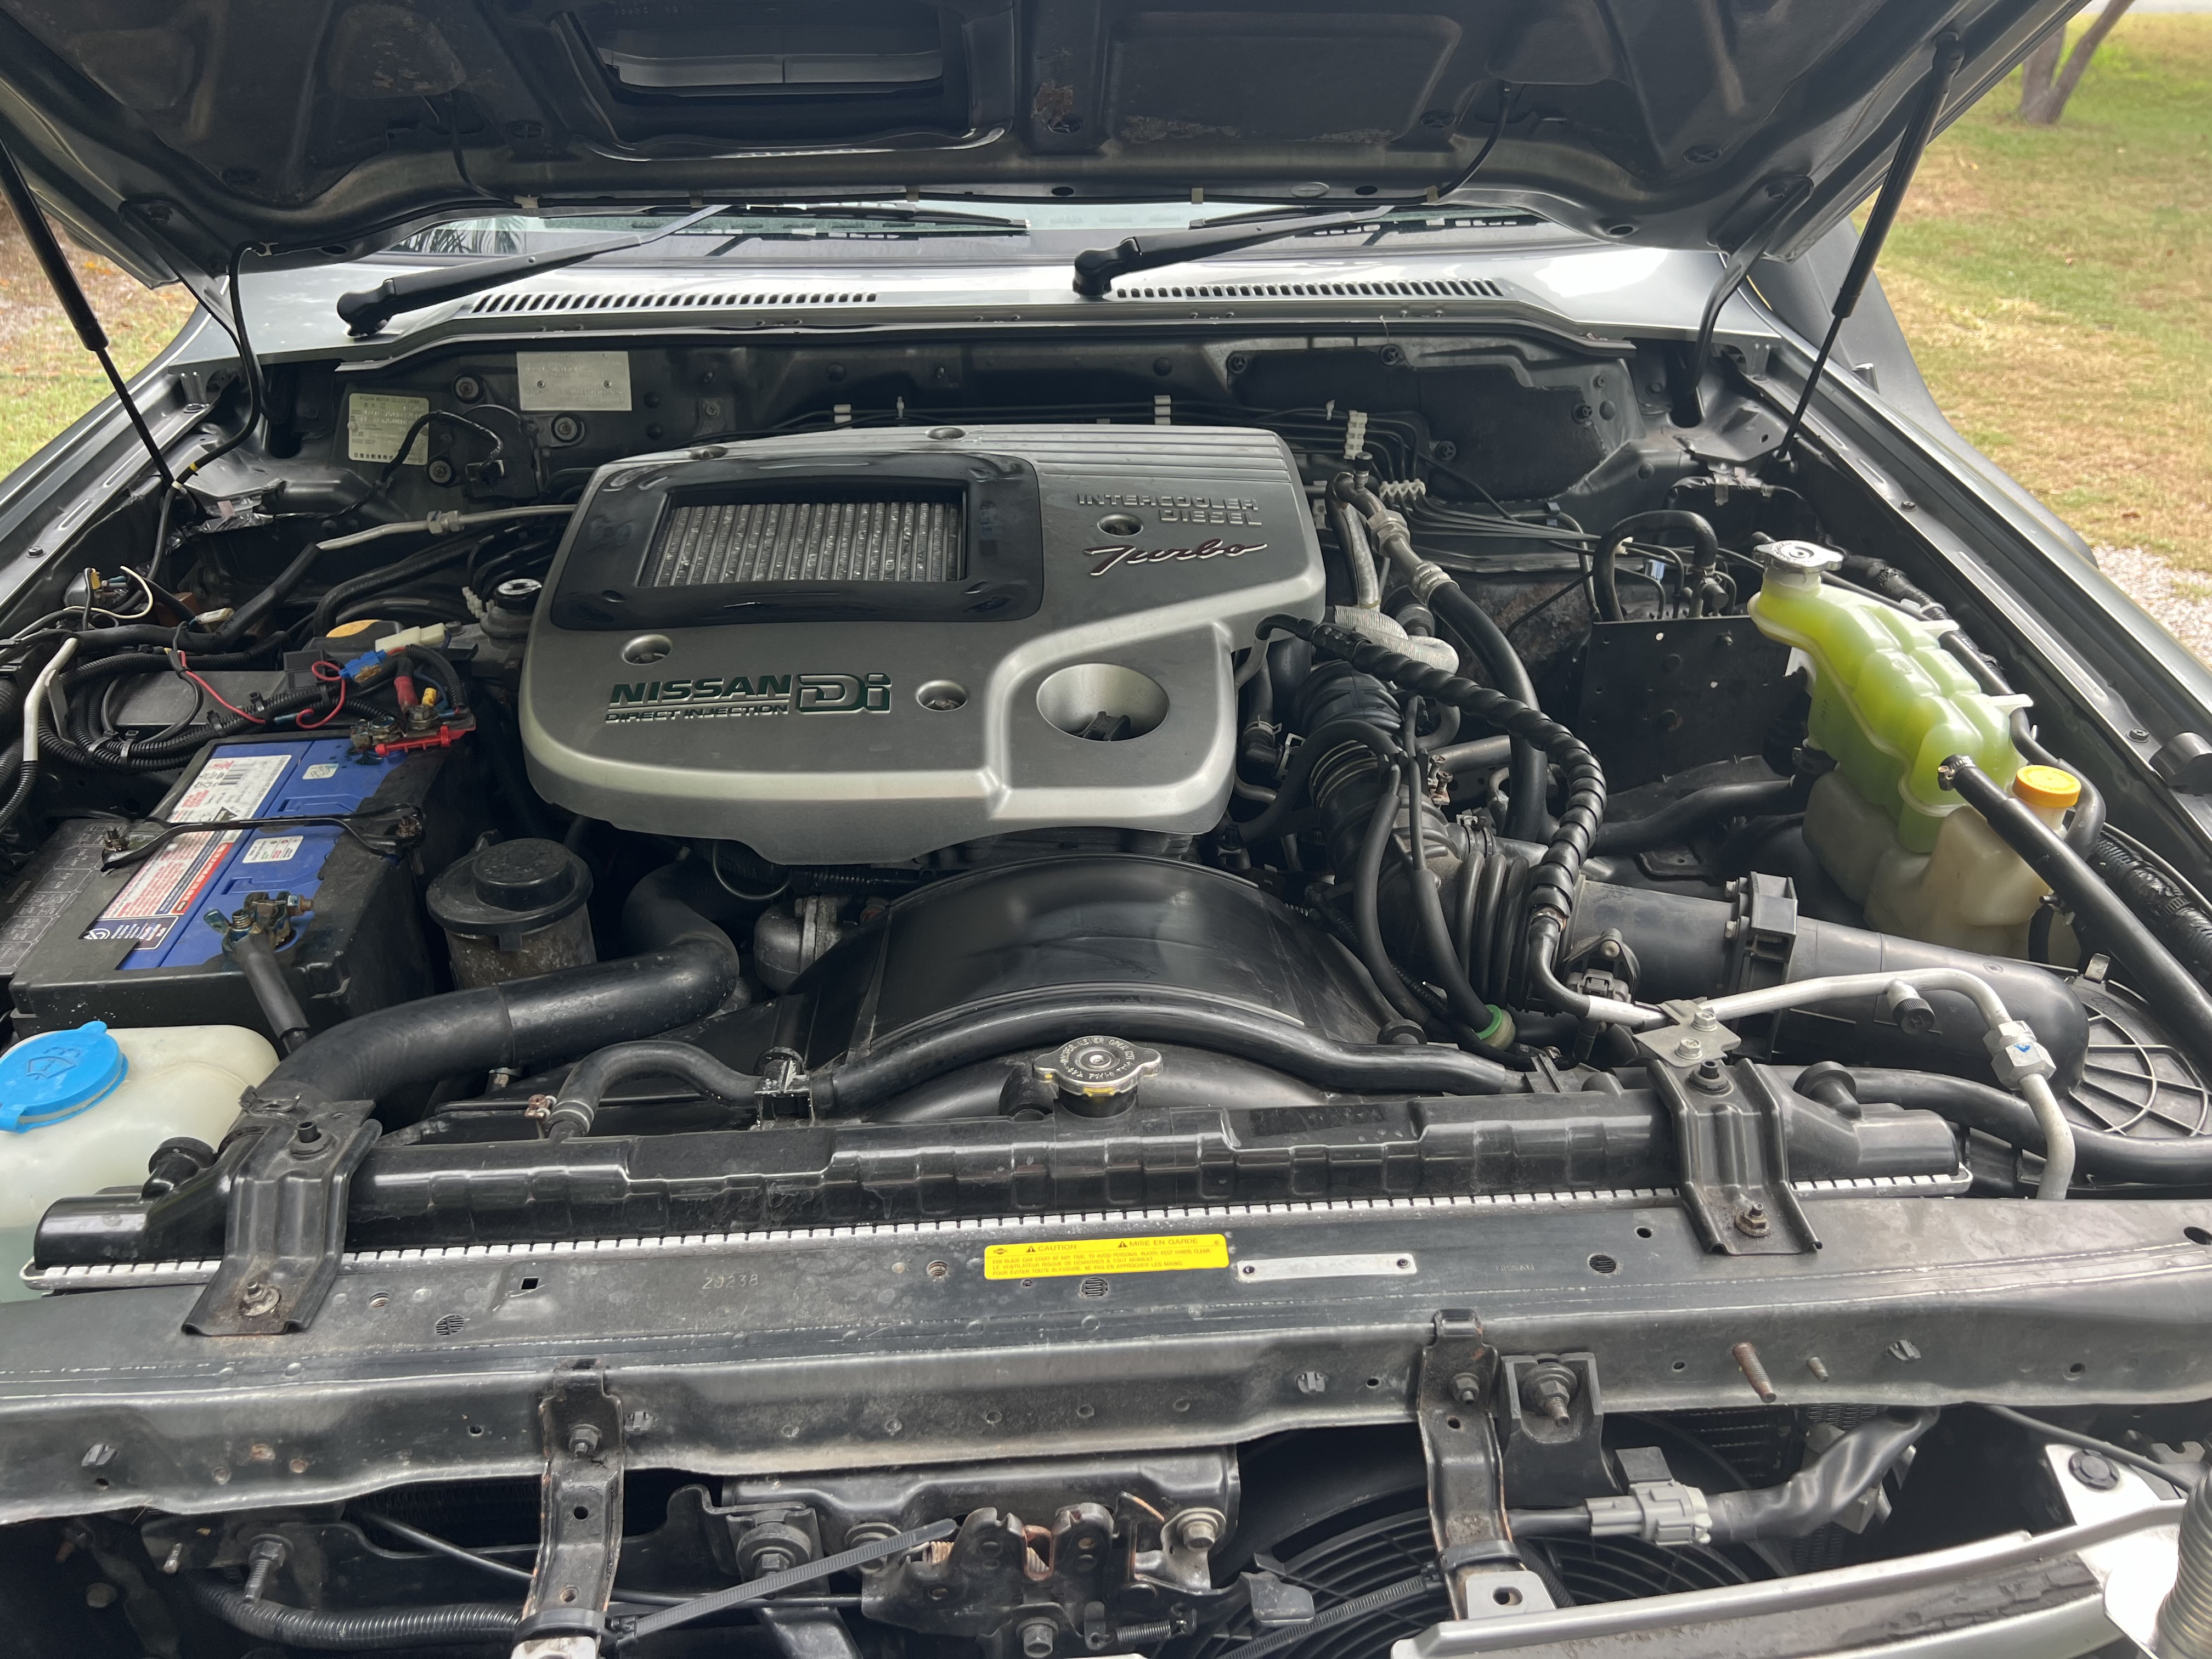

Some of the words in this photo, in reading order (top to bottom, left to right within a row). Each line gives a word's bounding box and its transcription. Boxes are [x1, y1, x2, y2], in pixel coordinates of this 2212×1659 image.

[1077, 493, 1259, 511] INTERCOOLER
[1160, 509, 1262, 526] DIESEL
[1084, 538, 1268, 577] Turbo
[610, 674, 793, 707] NISSAN
[796, 673, 892, 714] Di
[605, 709, 681, 724] DIRECT
[684, 704, 789, 720] INJECTION
